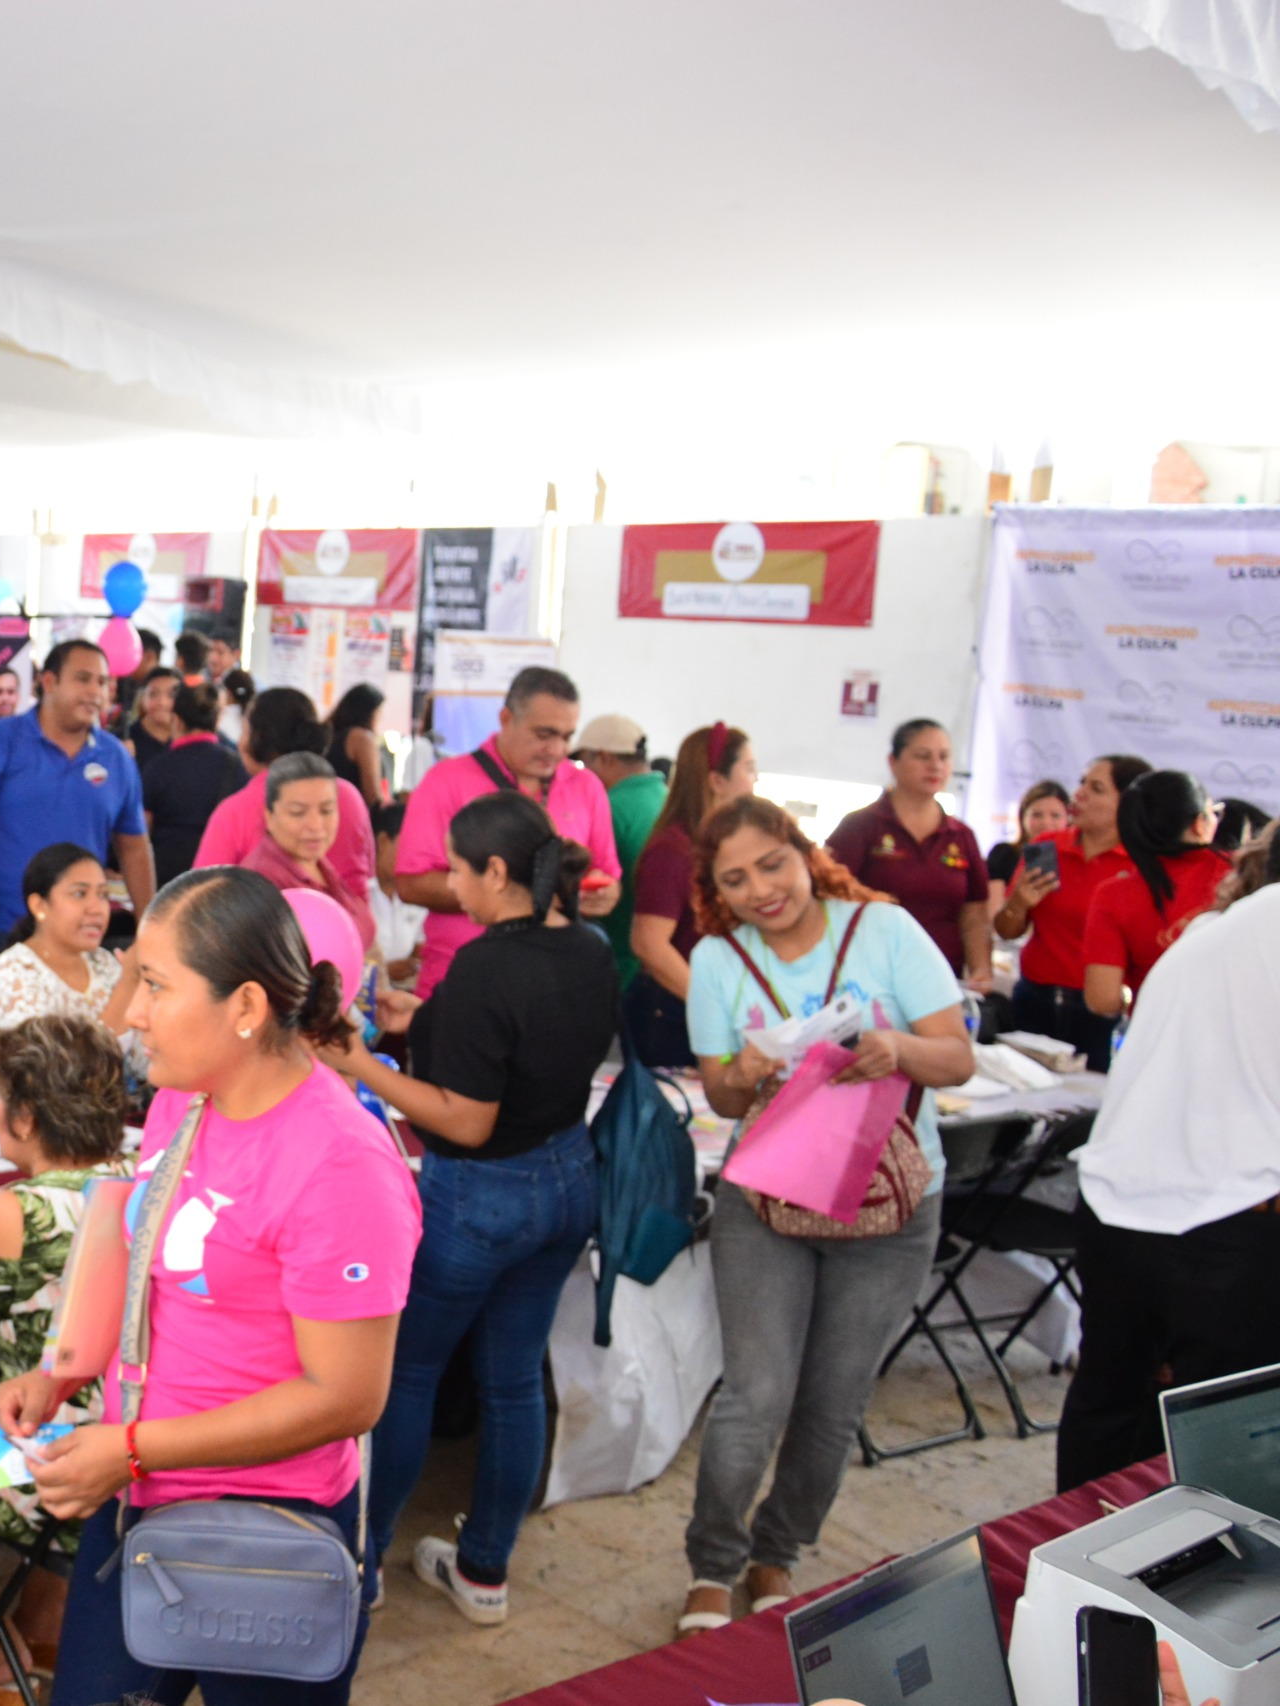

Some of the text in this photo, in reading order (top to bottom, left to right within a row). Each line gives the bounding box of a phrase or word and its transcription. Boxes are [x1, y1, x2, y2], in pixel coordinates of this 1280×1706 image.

[1229, 567, 1246, 579] LA
[1118, 636, 1178, 651] LA CULPA
[1221, 711, 1236, 725] LA
[159, 1604, 314, 1647] GUESS
